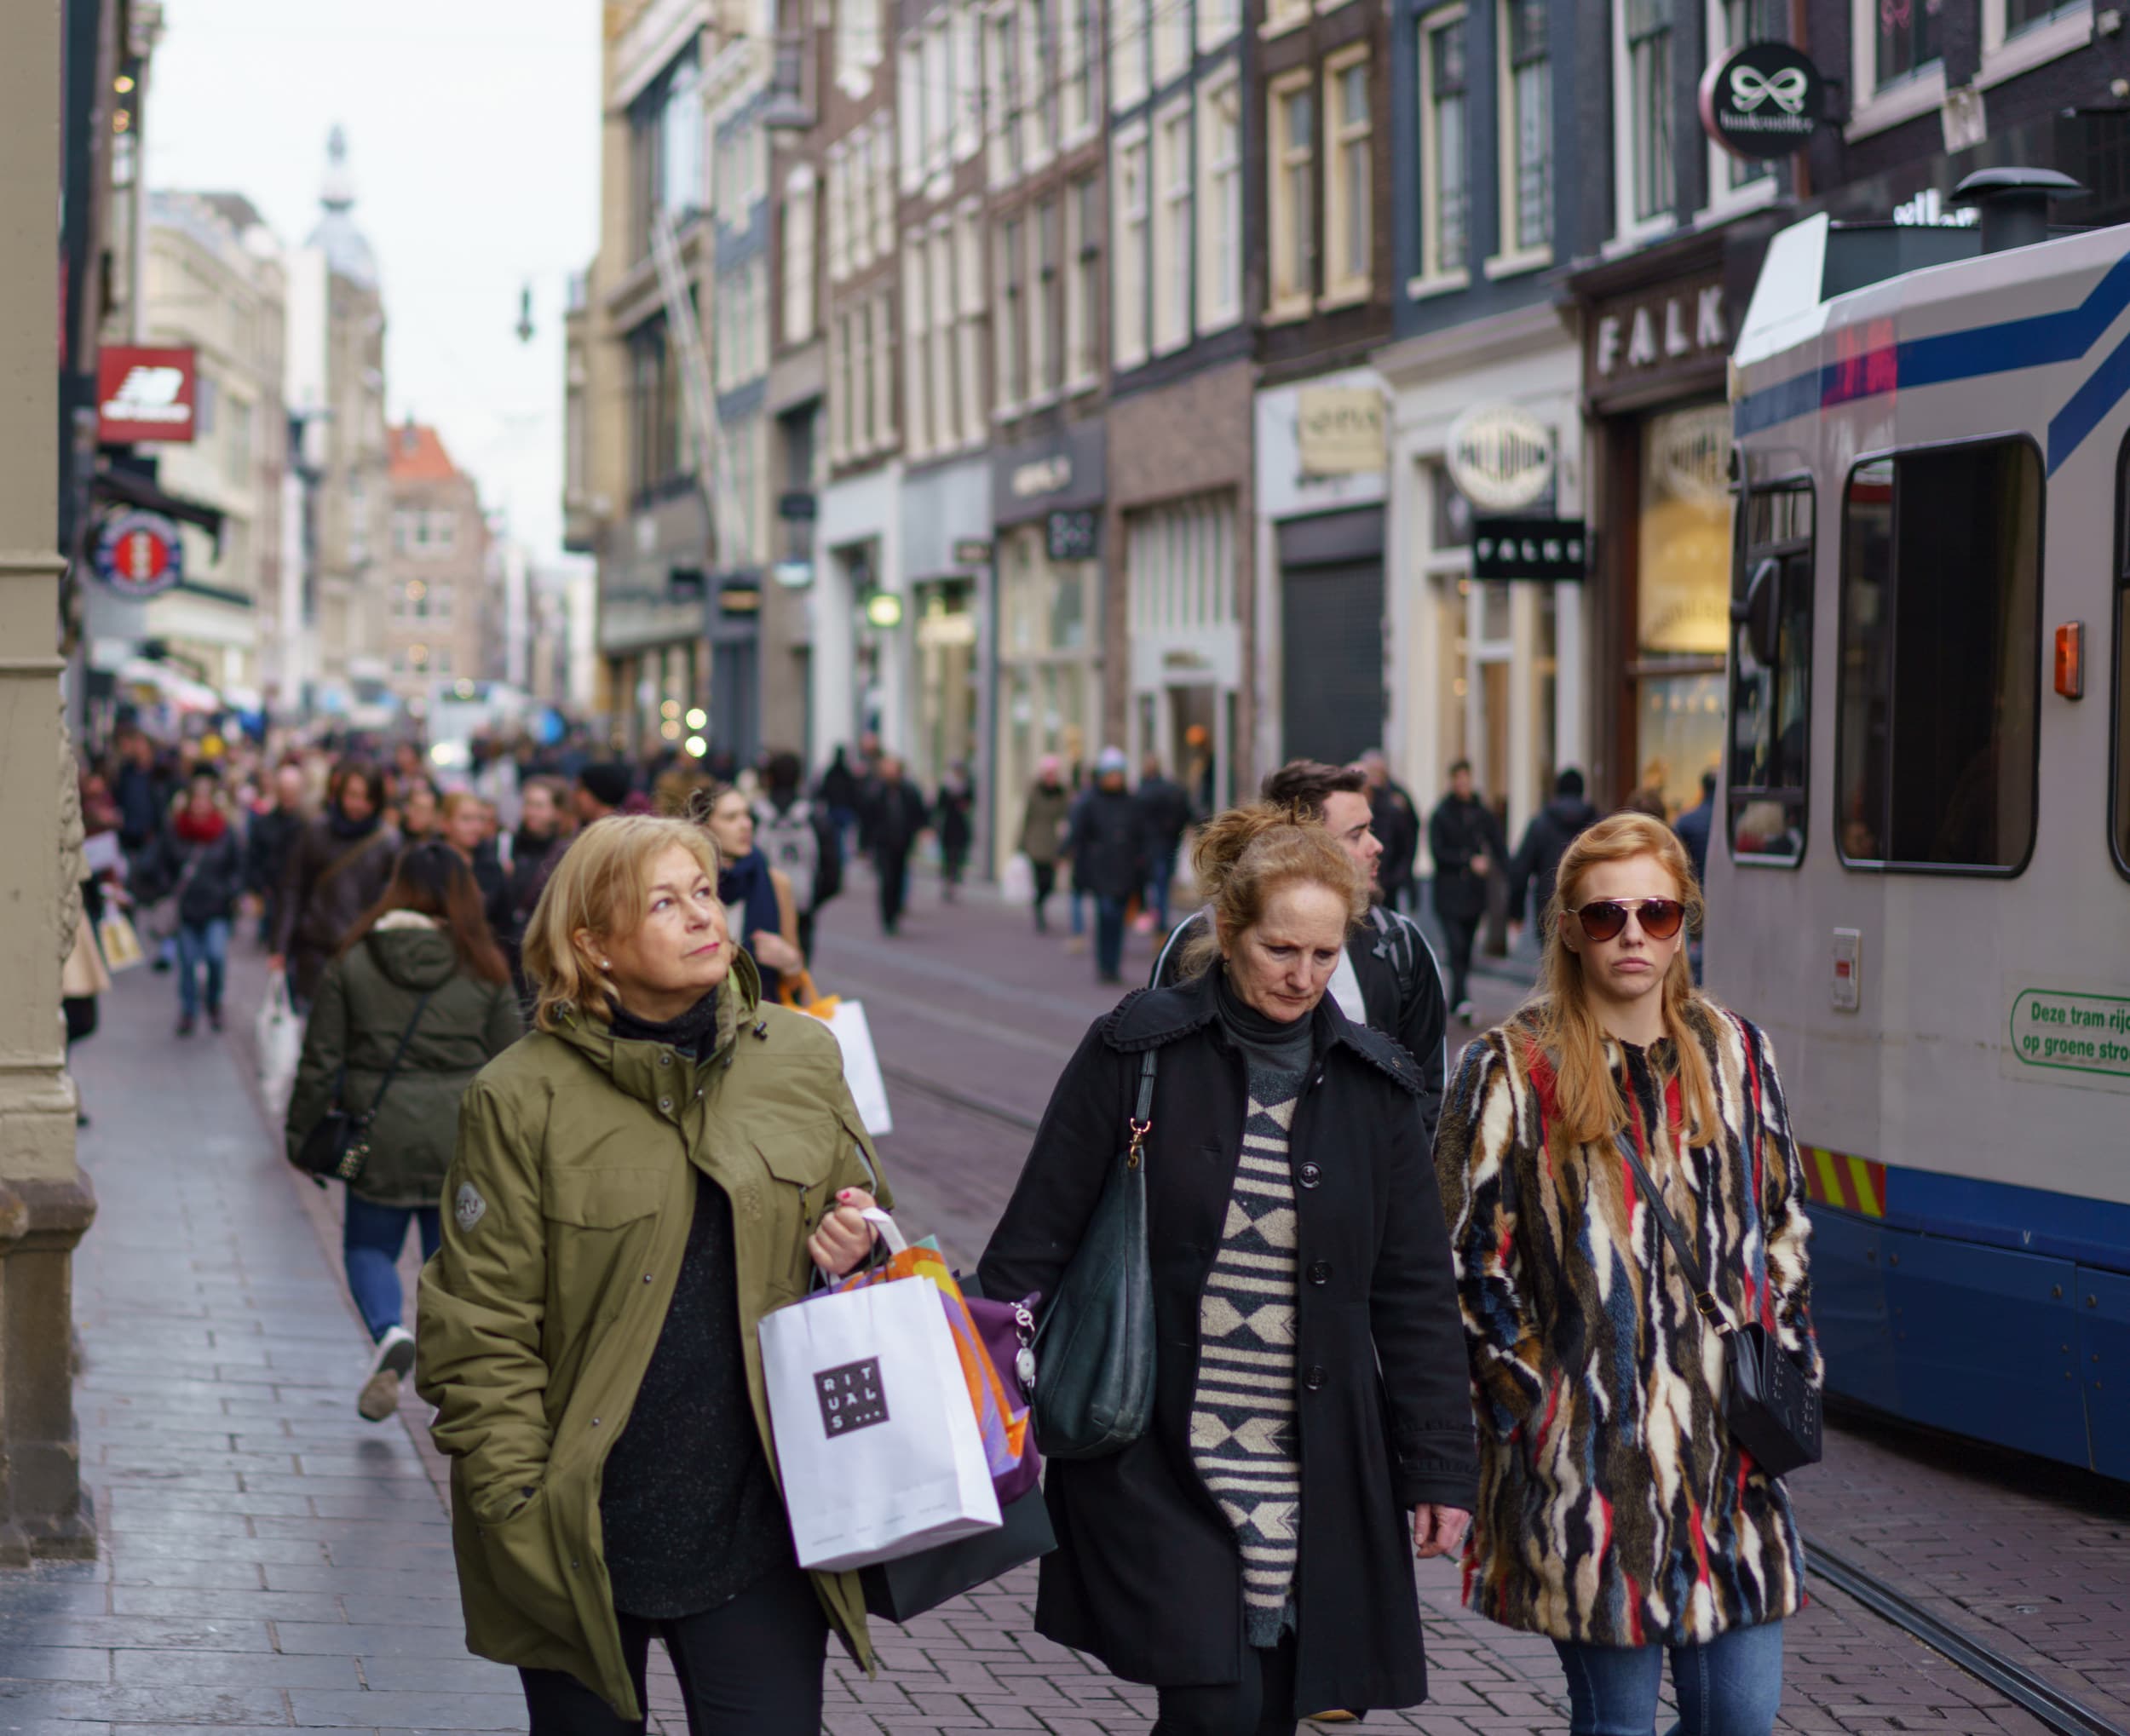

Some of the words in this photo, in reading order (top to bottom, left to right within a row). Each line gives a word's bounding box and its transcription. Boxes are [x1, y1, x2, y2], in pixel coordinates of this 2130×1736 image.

[2031, 1001, 2066, 1023] Deze
[2070, 1005, 2105, 1027] tram
[2023, 1035, 2041, 1055] op
[2045, 1037, 2095, 1057] groene
[2098, 1040, 2130, 1062] stro
